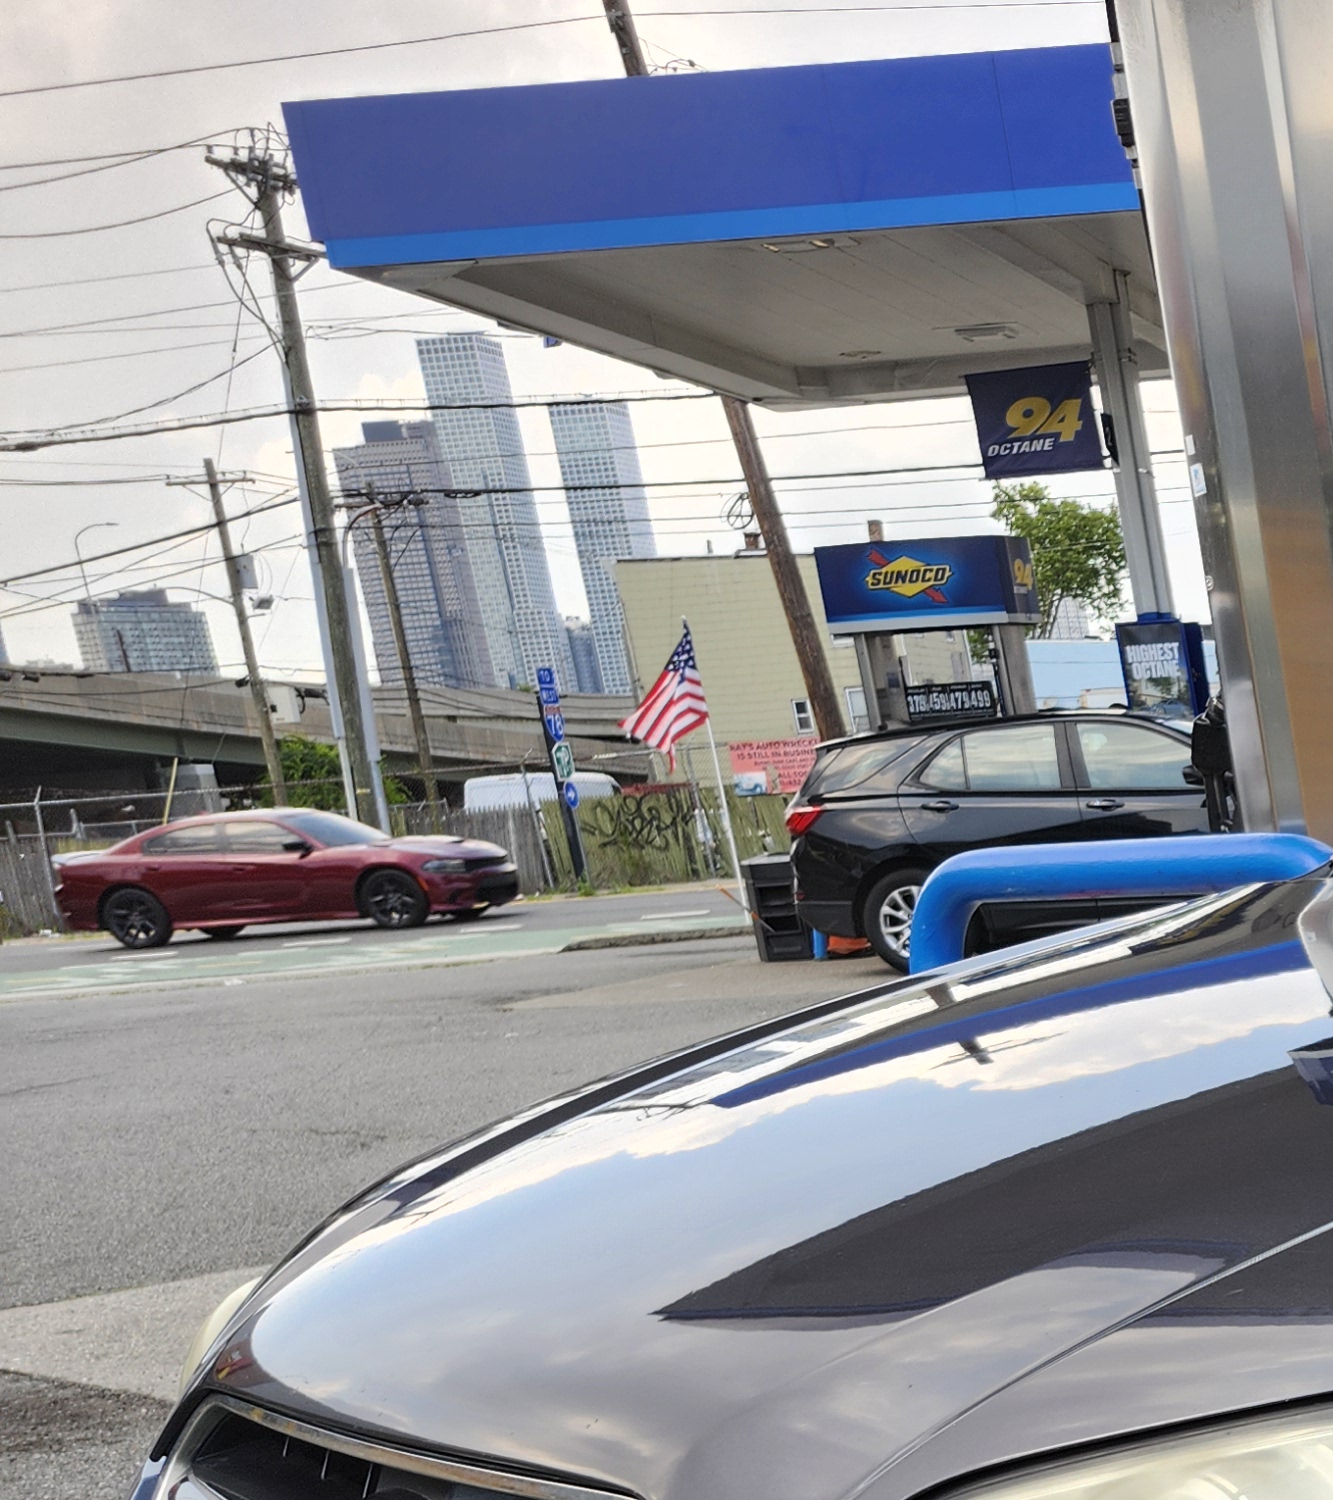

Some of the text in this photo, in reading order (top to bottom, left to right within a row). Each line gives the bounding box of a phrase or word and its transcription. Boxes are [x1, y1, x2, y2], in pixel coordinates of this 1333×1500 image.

[1005, 396, 1083, 443] 94
[987, 437, 1055, 457] OCTANE
[870, 566, 948, 588] SUNOCO
[1014, 559, 1033, 591] 94
[1126, 642, 1179, 664] HIGHEST
[539, 671, 550, 682] TO
[1131, 660, 1181, 681] OCTANE
[547, 714, 564, 735] 78
[747, 752, 769, 760] STILL
[783, 749, 815, 758] BUSINE
[756, 742, 780, 751] AUTO
[783, 739, 818, 748] WRECK
